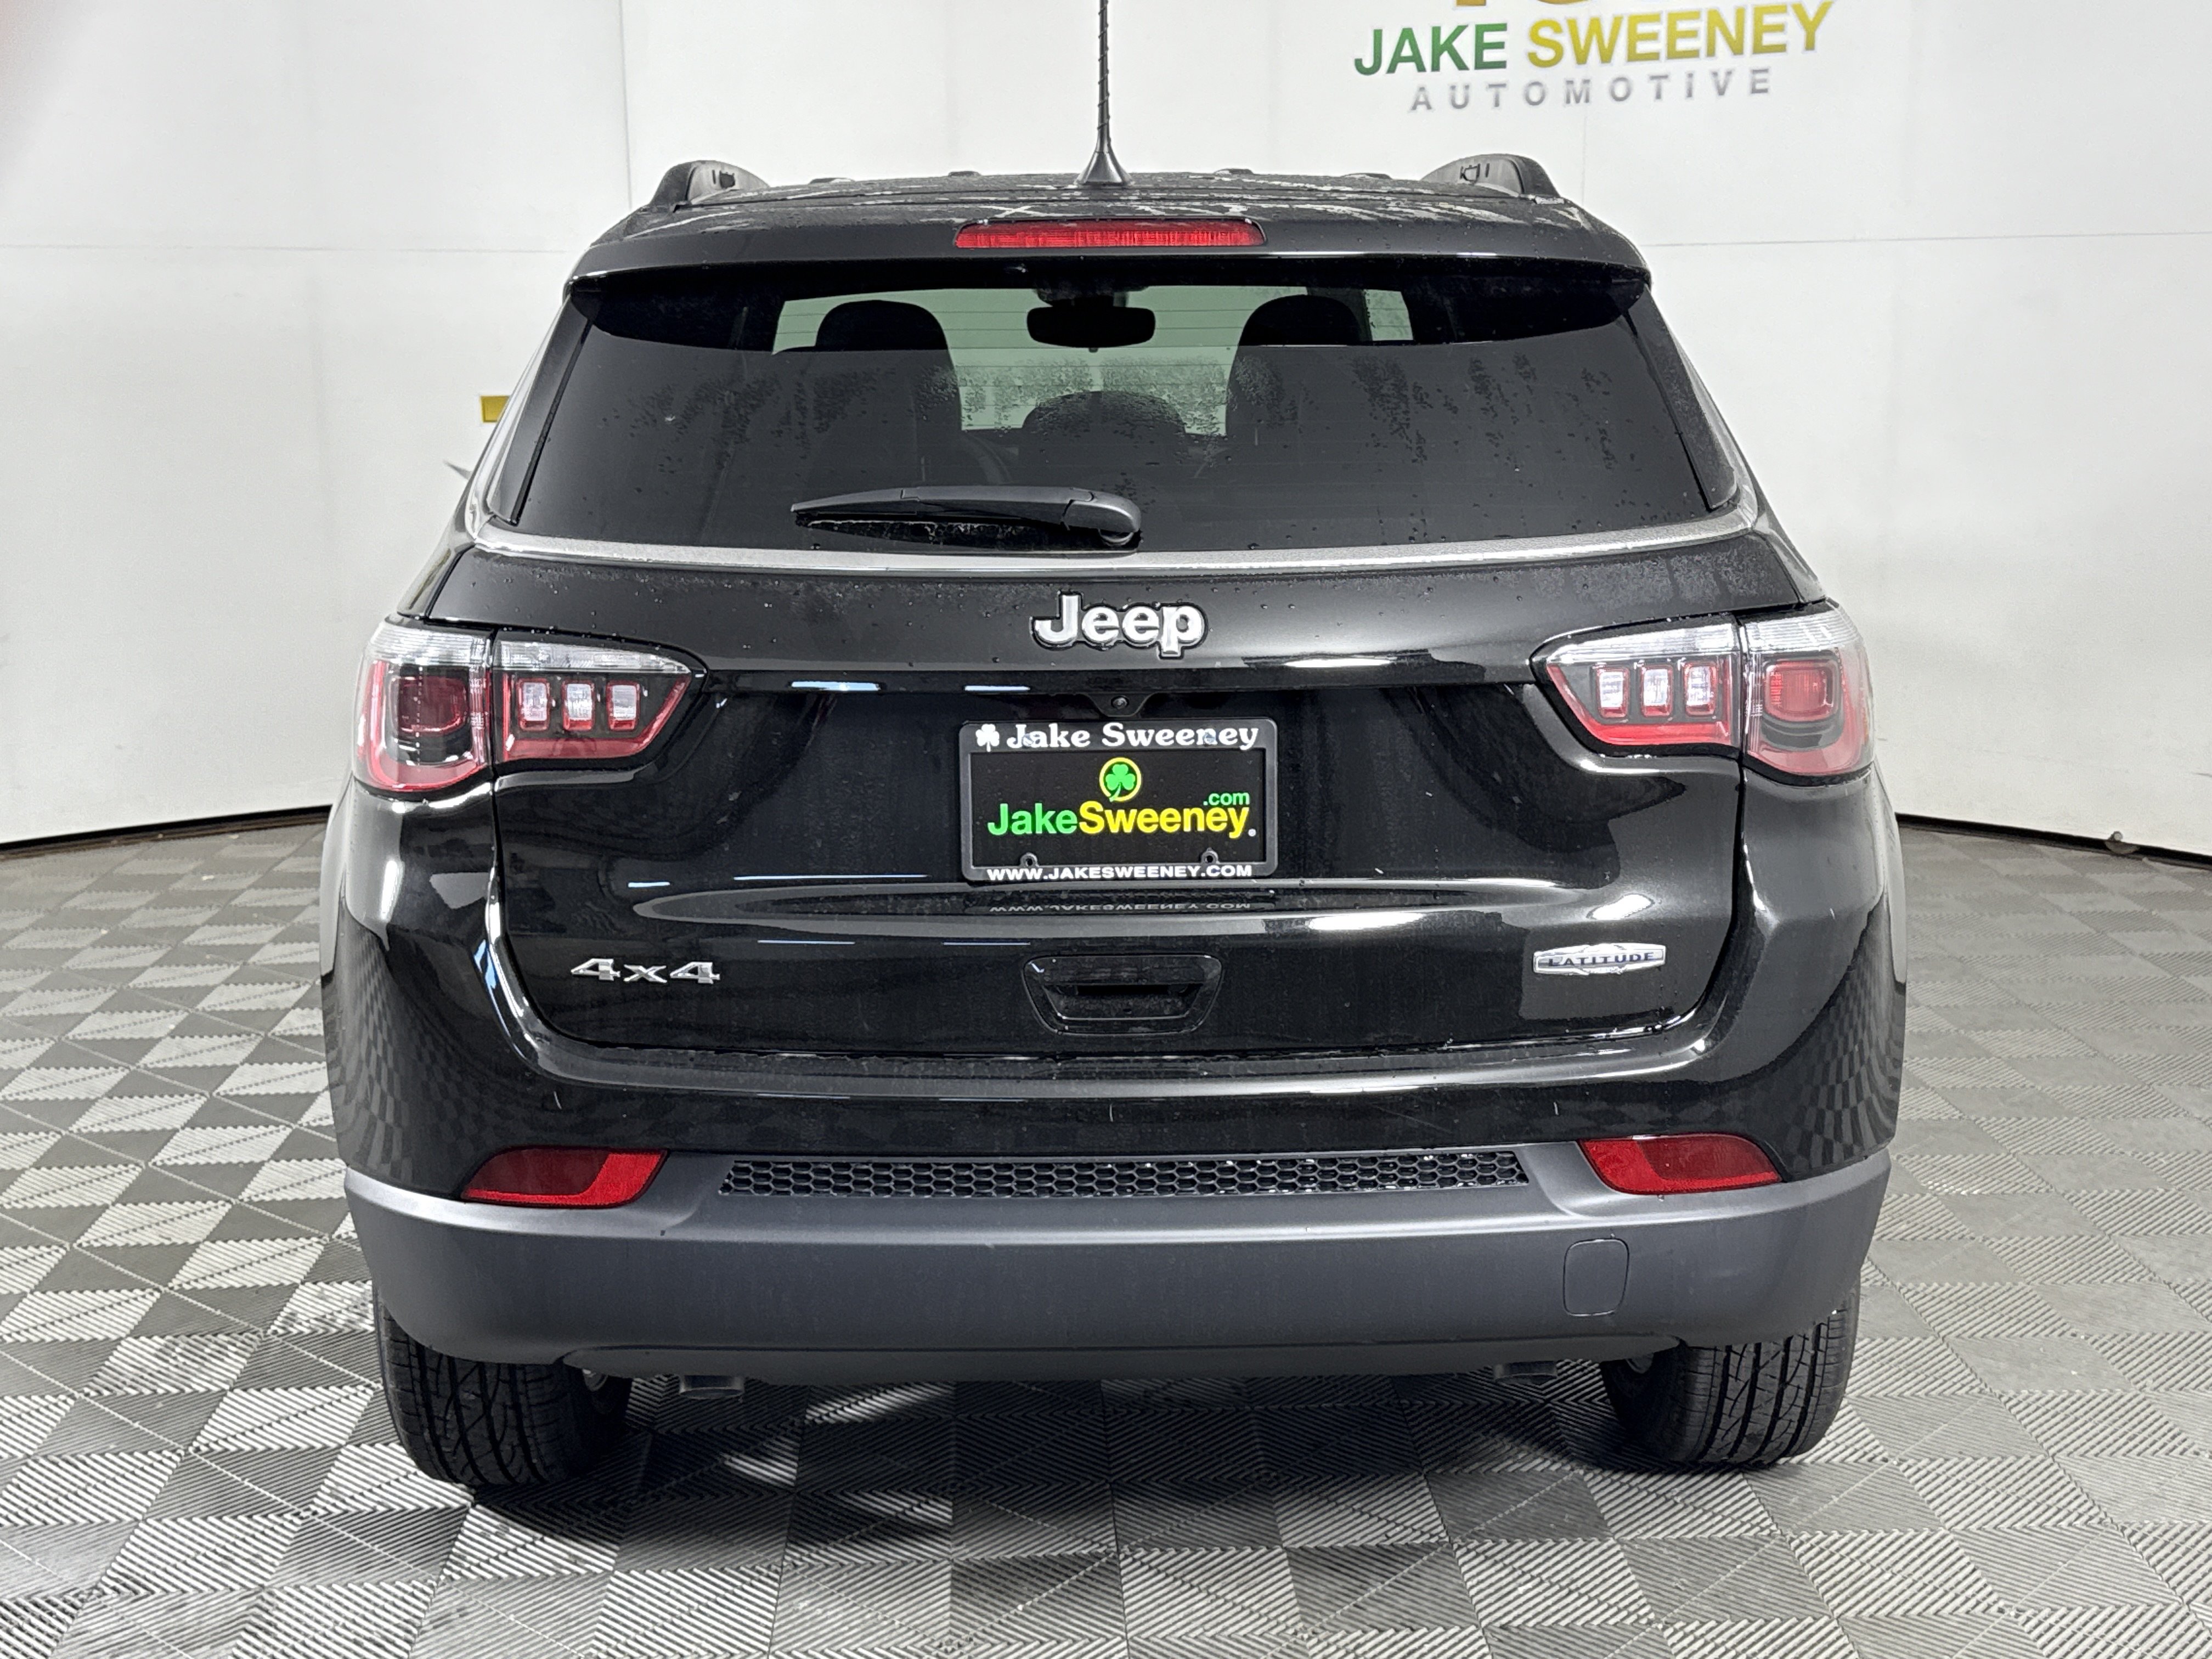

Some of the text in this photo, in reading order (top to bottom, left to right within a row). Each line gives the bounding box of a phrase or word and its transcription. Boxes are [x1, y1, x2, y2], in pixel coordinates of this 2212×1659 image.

[1353, 1, 1833, 76] JAKE SWEENEY
[1410, 68, 1770, 111] AUTOMOTIVE
[1034, 592, 1206, 656] Jeep
[1007, 722, 1259, 751] Jake Sweeney
[987, 865, 1252, 881] WWW.JAKESWEENEY.COM
[1548, 952, 1654, 967] LATITUDE
